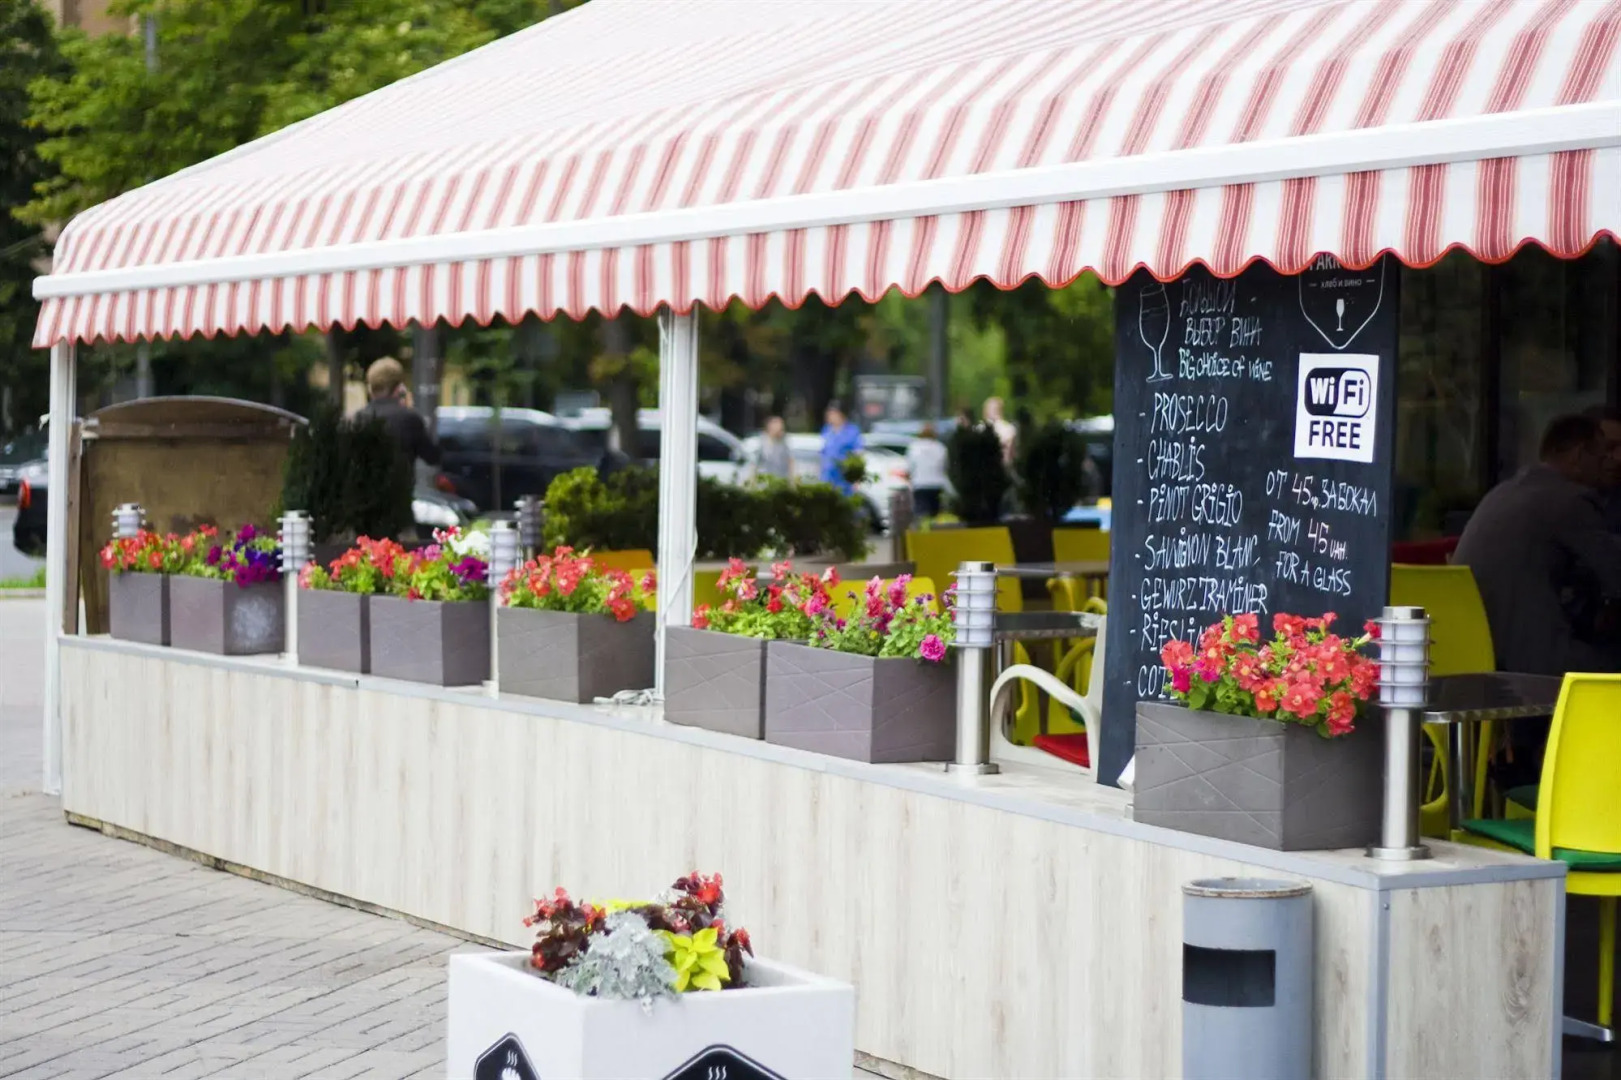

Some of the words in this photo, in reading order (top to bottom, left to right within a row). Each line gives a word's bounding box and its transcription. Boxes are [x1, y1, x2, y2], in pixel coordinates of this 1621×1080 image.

[1150, 391, 1228, 435] PROSECCO
[1308, 420, 1362, 450] FREE
[1147, 436, 1206, 482] CHABLIS
[1268, 509, 1301, 546] FROM
[1307, 518, 1330, 554] 45
[1275, 550, 1300, 585] FOR
[1300, 559, 1310, 588] A
[1313, 566, 1352, 597] GLASS
